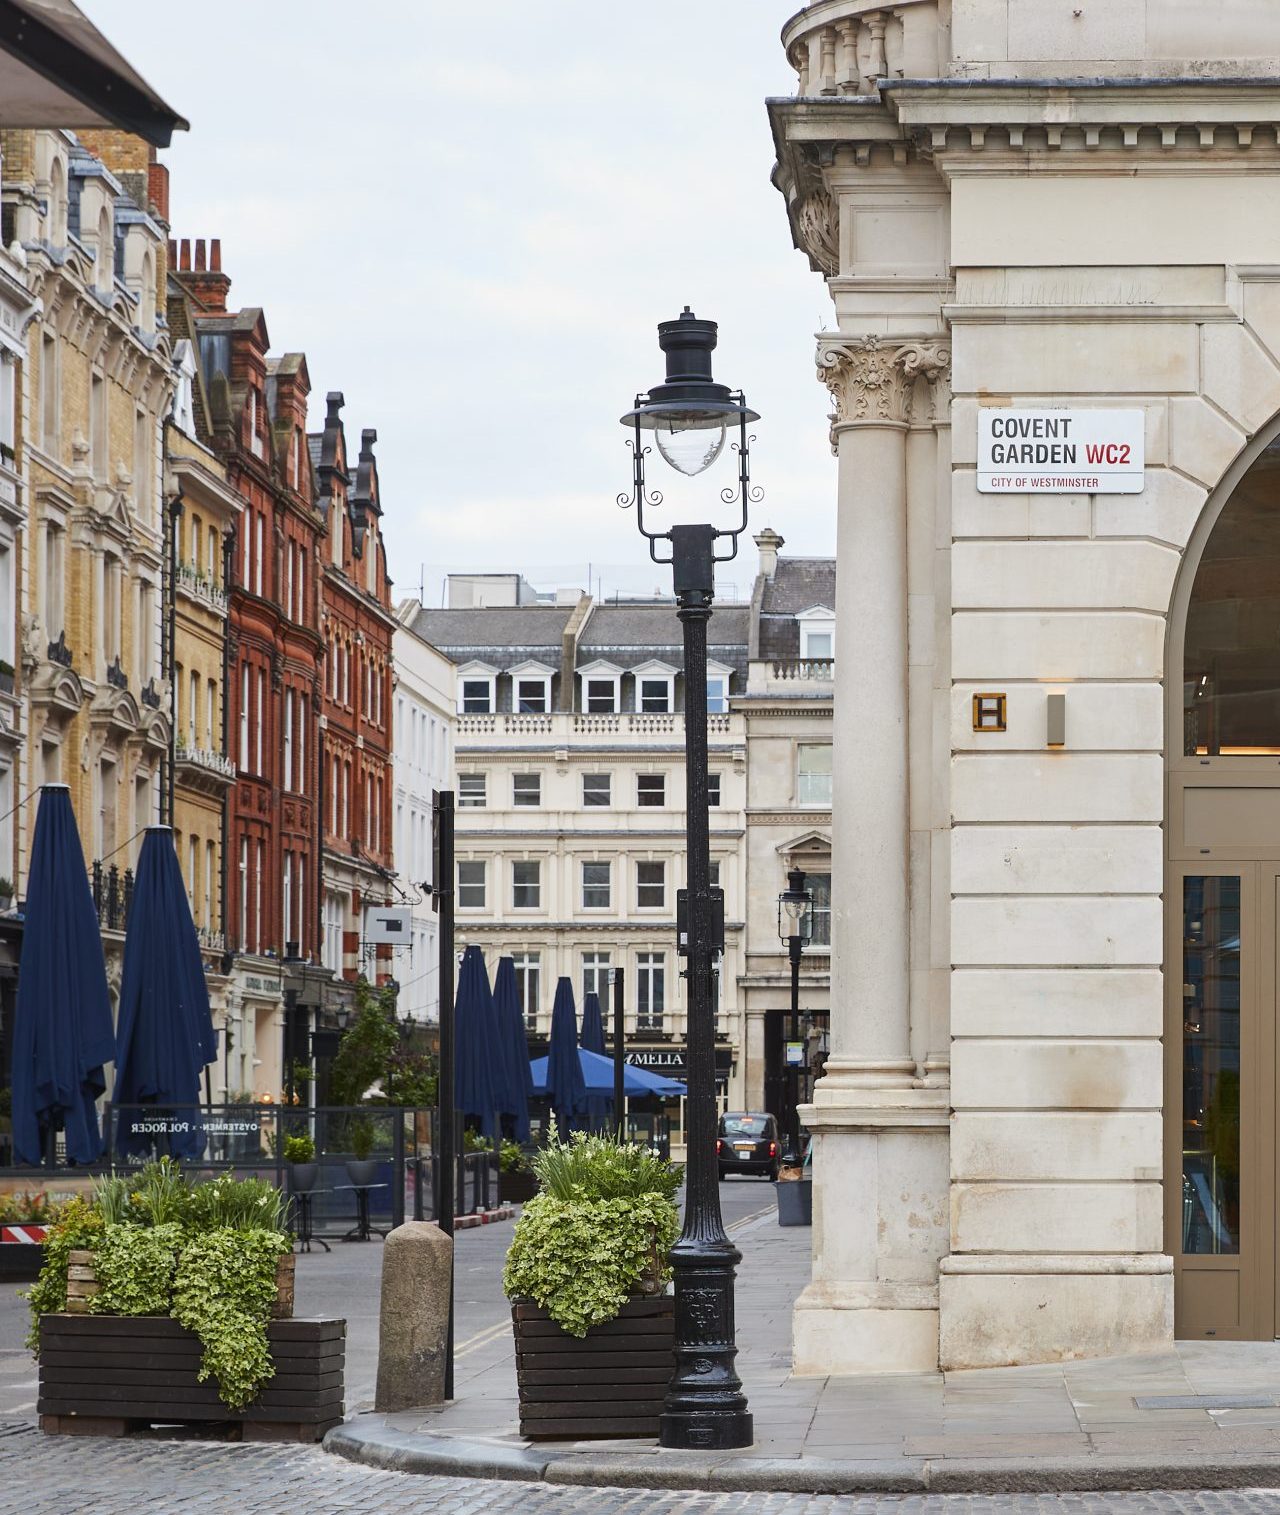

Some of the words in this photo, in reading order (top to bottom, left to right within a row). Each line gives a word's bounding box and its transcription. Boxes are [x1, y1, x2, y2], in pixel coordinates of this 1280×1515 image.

[991, 418, 1072, 438] COVENT
[991, 444, 1076, 464] GARDEN
[1086, 444, 1131, 464] WC2
[991, 477, 1012, 487] CITY
[1015, 477, 1027, 487] OF
[1031, 477, 1099, 487] WESTMINSTER
